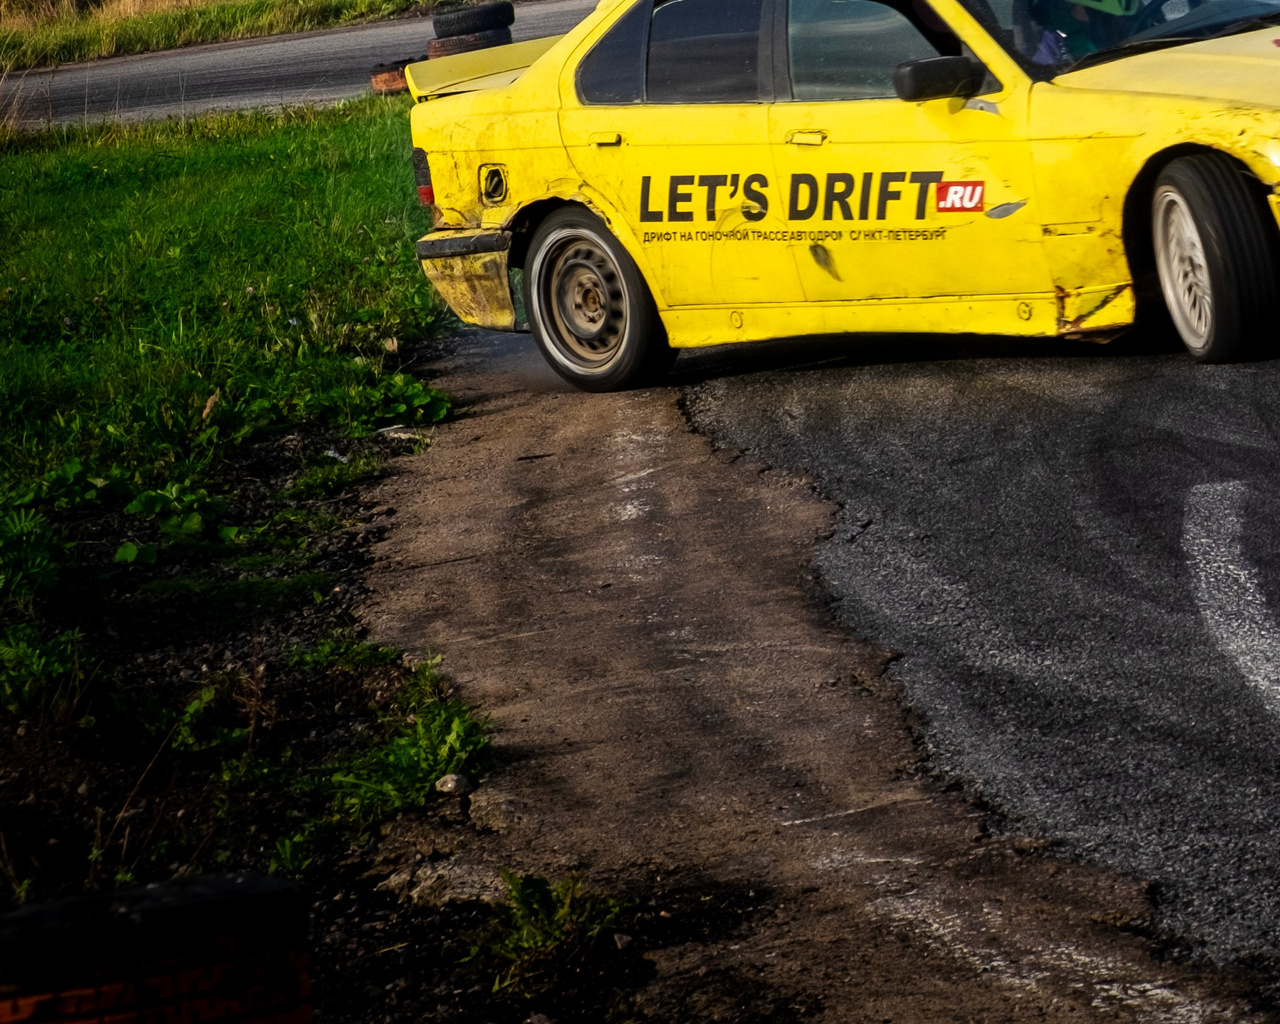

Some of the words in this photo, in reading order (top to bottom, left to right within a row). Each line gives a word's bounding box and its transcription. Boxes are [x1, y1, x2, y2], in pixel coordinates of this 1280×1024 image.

[639, 173, 769, 223] LET'S
[643, 231, 678, 244] ДРИФТ
[680, 232, 694, 242] НА
[751, 230, 788, 242] ТРАССЕ
